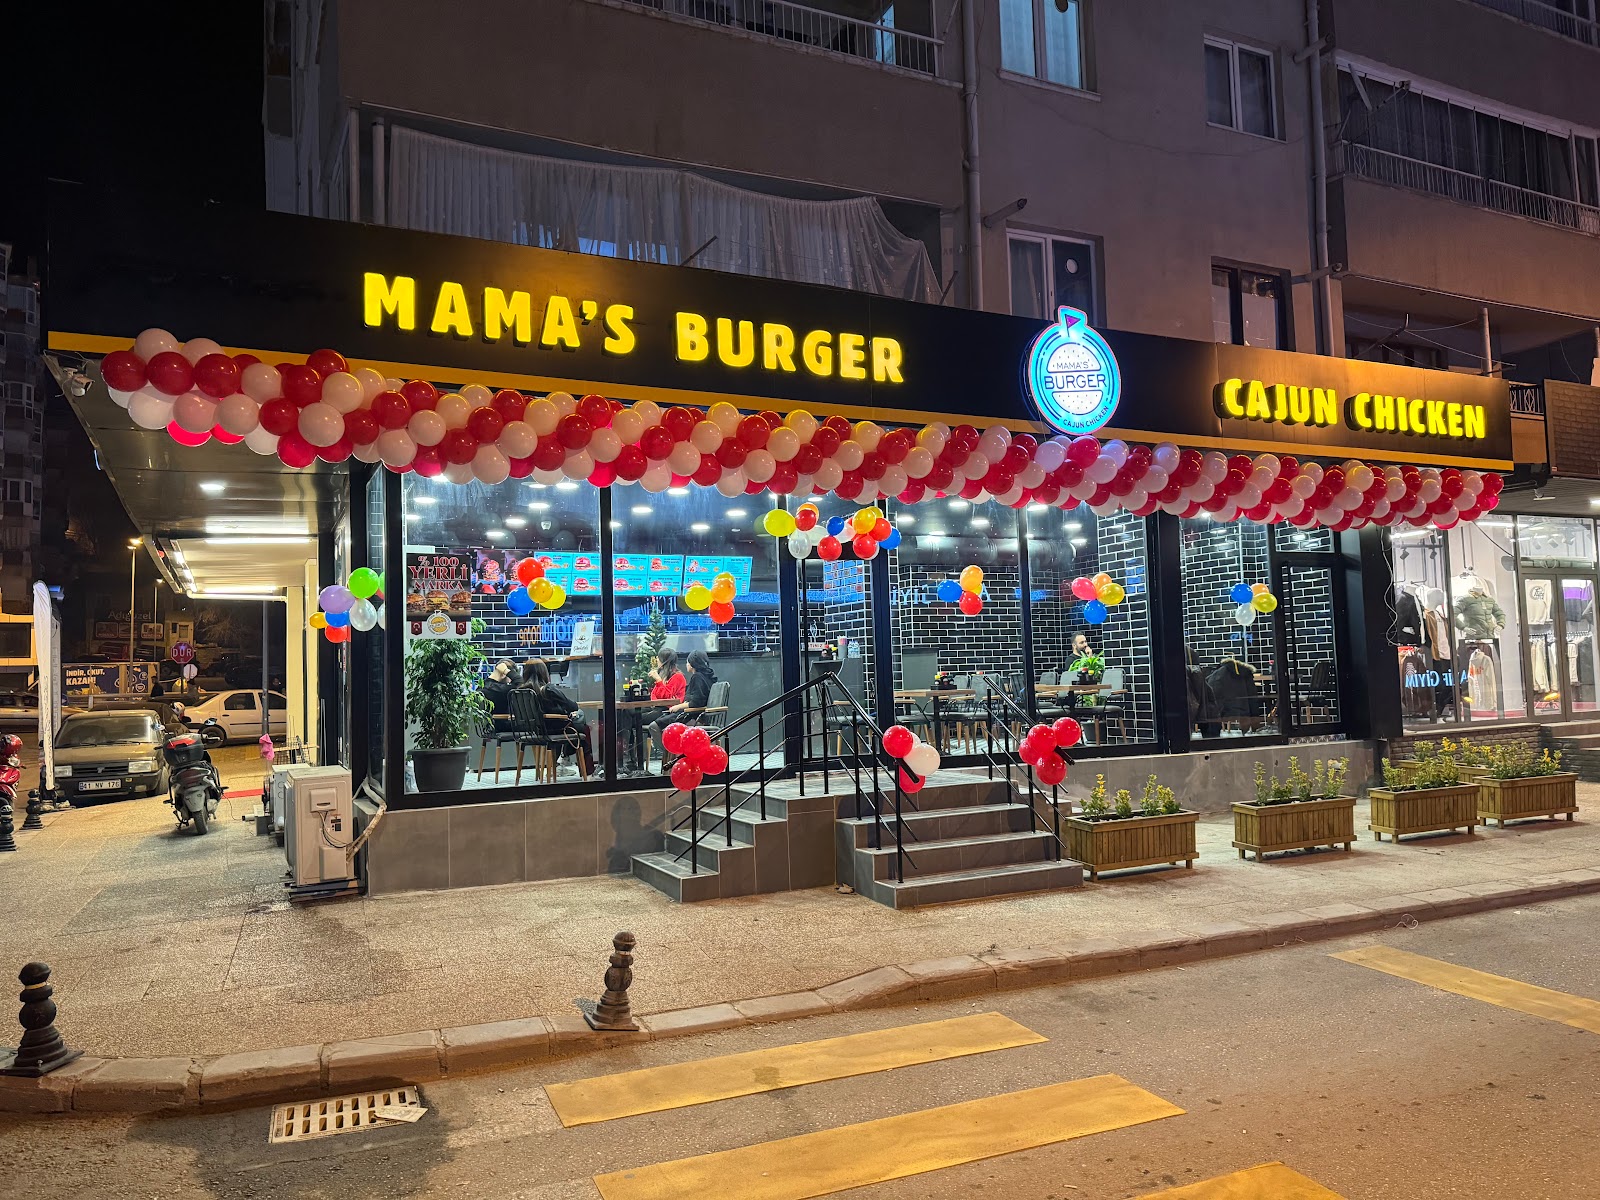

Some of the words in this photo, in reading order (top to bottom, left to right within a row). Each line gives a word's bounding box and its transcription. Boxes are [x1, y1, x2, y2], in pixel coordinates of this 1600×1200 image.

[363, 271, 636, 355] MAMA'S
[675, 311, 904, 383] BURGER
[1056, 361, 1089, 370] MAMA'S
[1044, 374, 1107, 389] BURGER
[1222, 377, 1338, 426] CAJUN
[1354, 391, 1487, 440] CHICKEN
[1063, 419, 1084, 428] CAJUN
[1086, 406, 1108, 426] CHICKEN
[432, 556, 460, 567] 100
[407, 563, 469, 581] YERLİ
[413, 579, 465, 591] MARKA
[172, 648, 192, 657] DUR
[66, 668, 87, 677] İNDİR.
